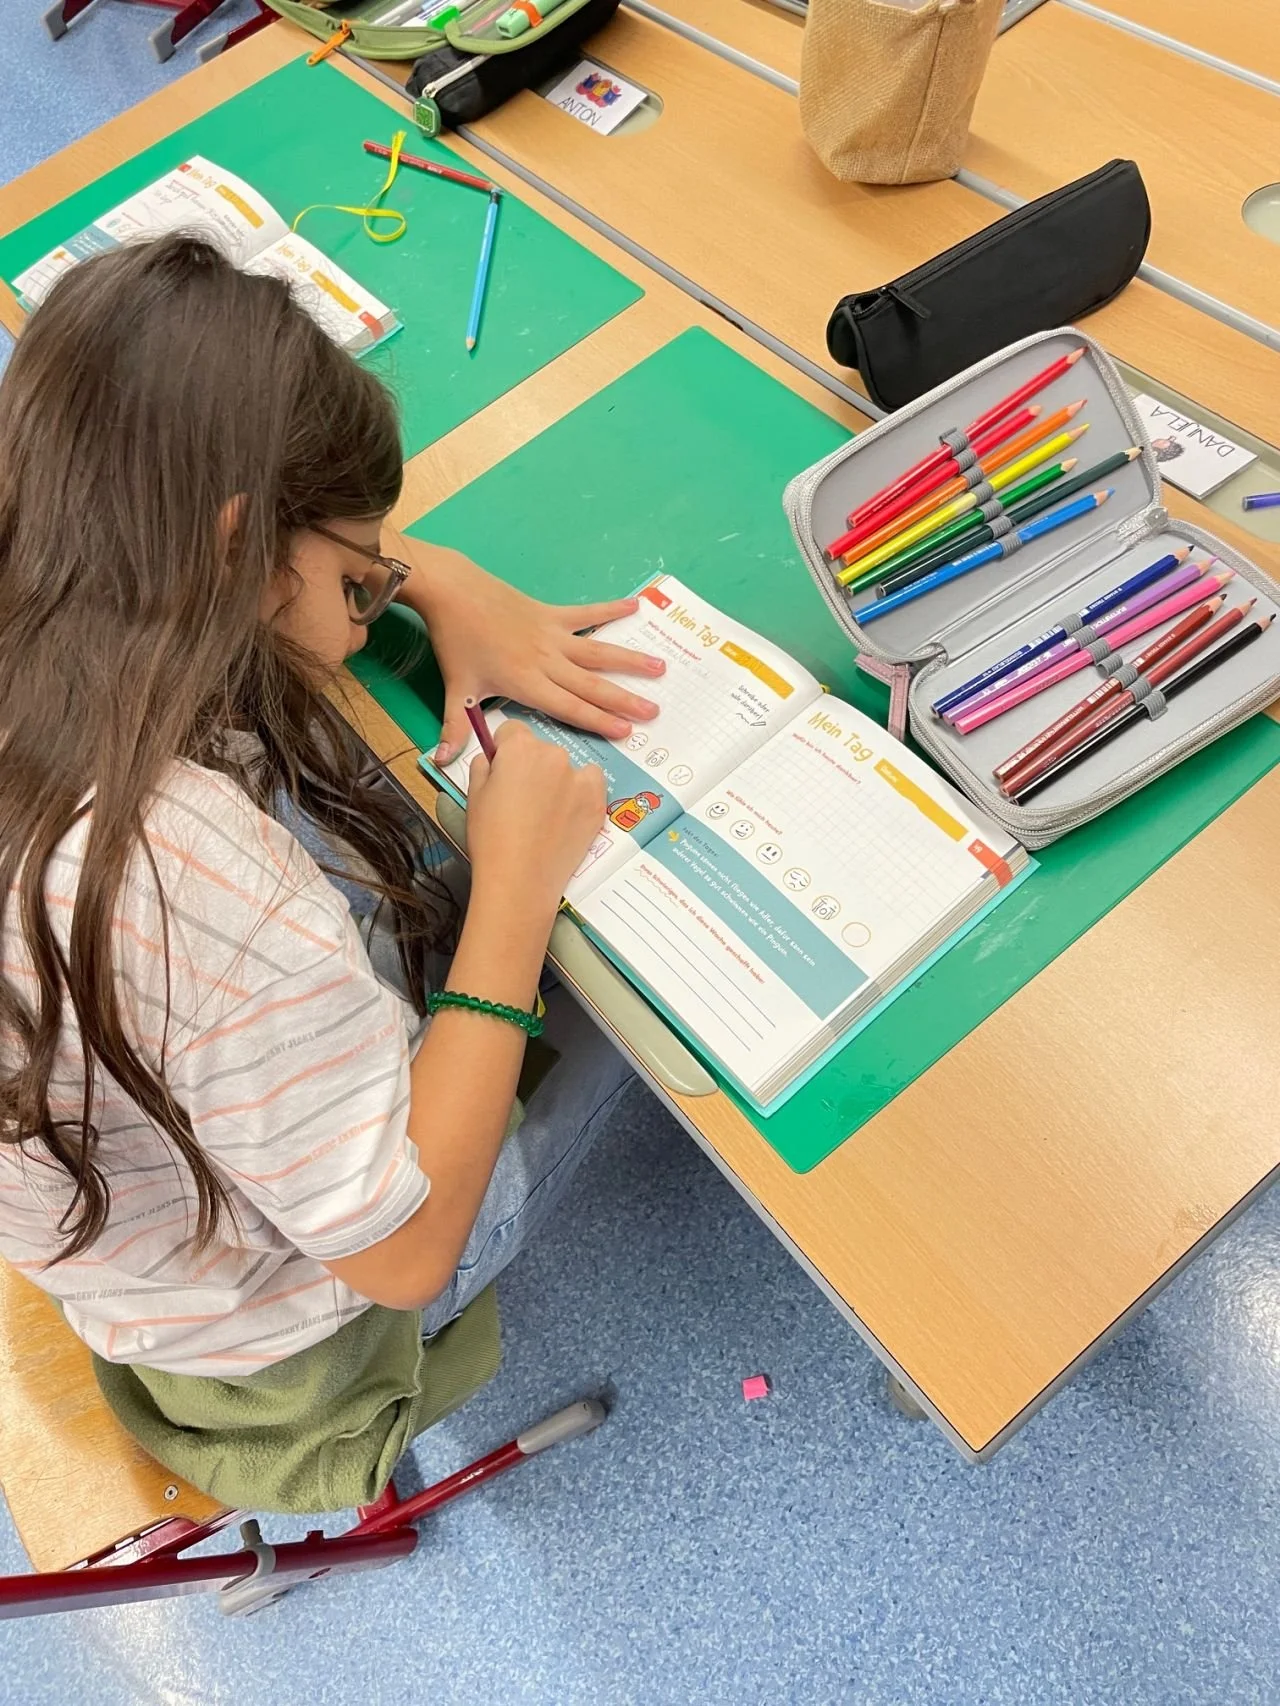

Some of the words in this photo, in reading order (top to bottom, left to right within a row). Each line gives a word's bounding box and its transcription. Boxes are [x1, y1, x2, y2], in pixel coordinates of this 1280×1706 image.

[559, 97, 601, 126] ANTON
[1150, 405, 1236, 458] DANIJELA
[667, 605, 699, 633] Mein
[697, 625, 720, 648] Tag
[807, 711, 842, 739] Mein
[840, 731, 875, 763] Tag
